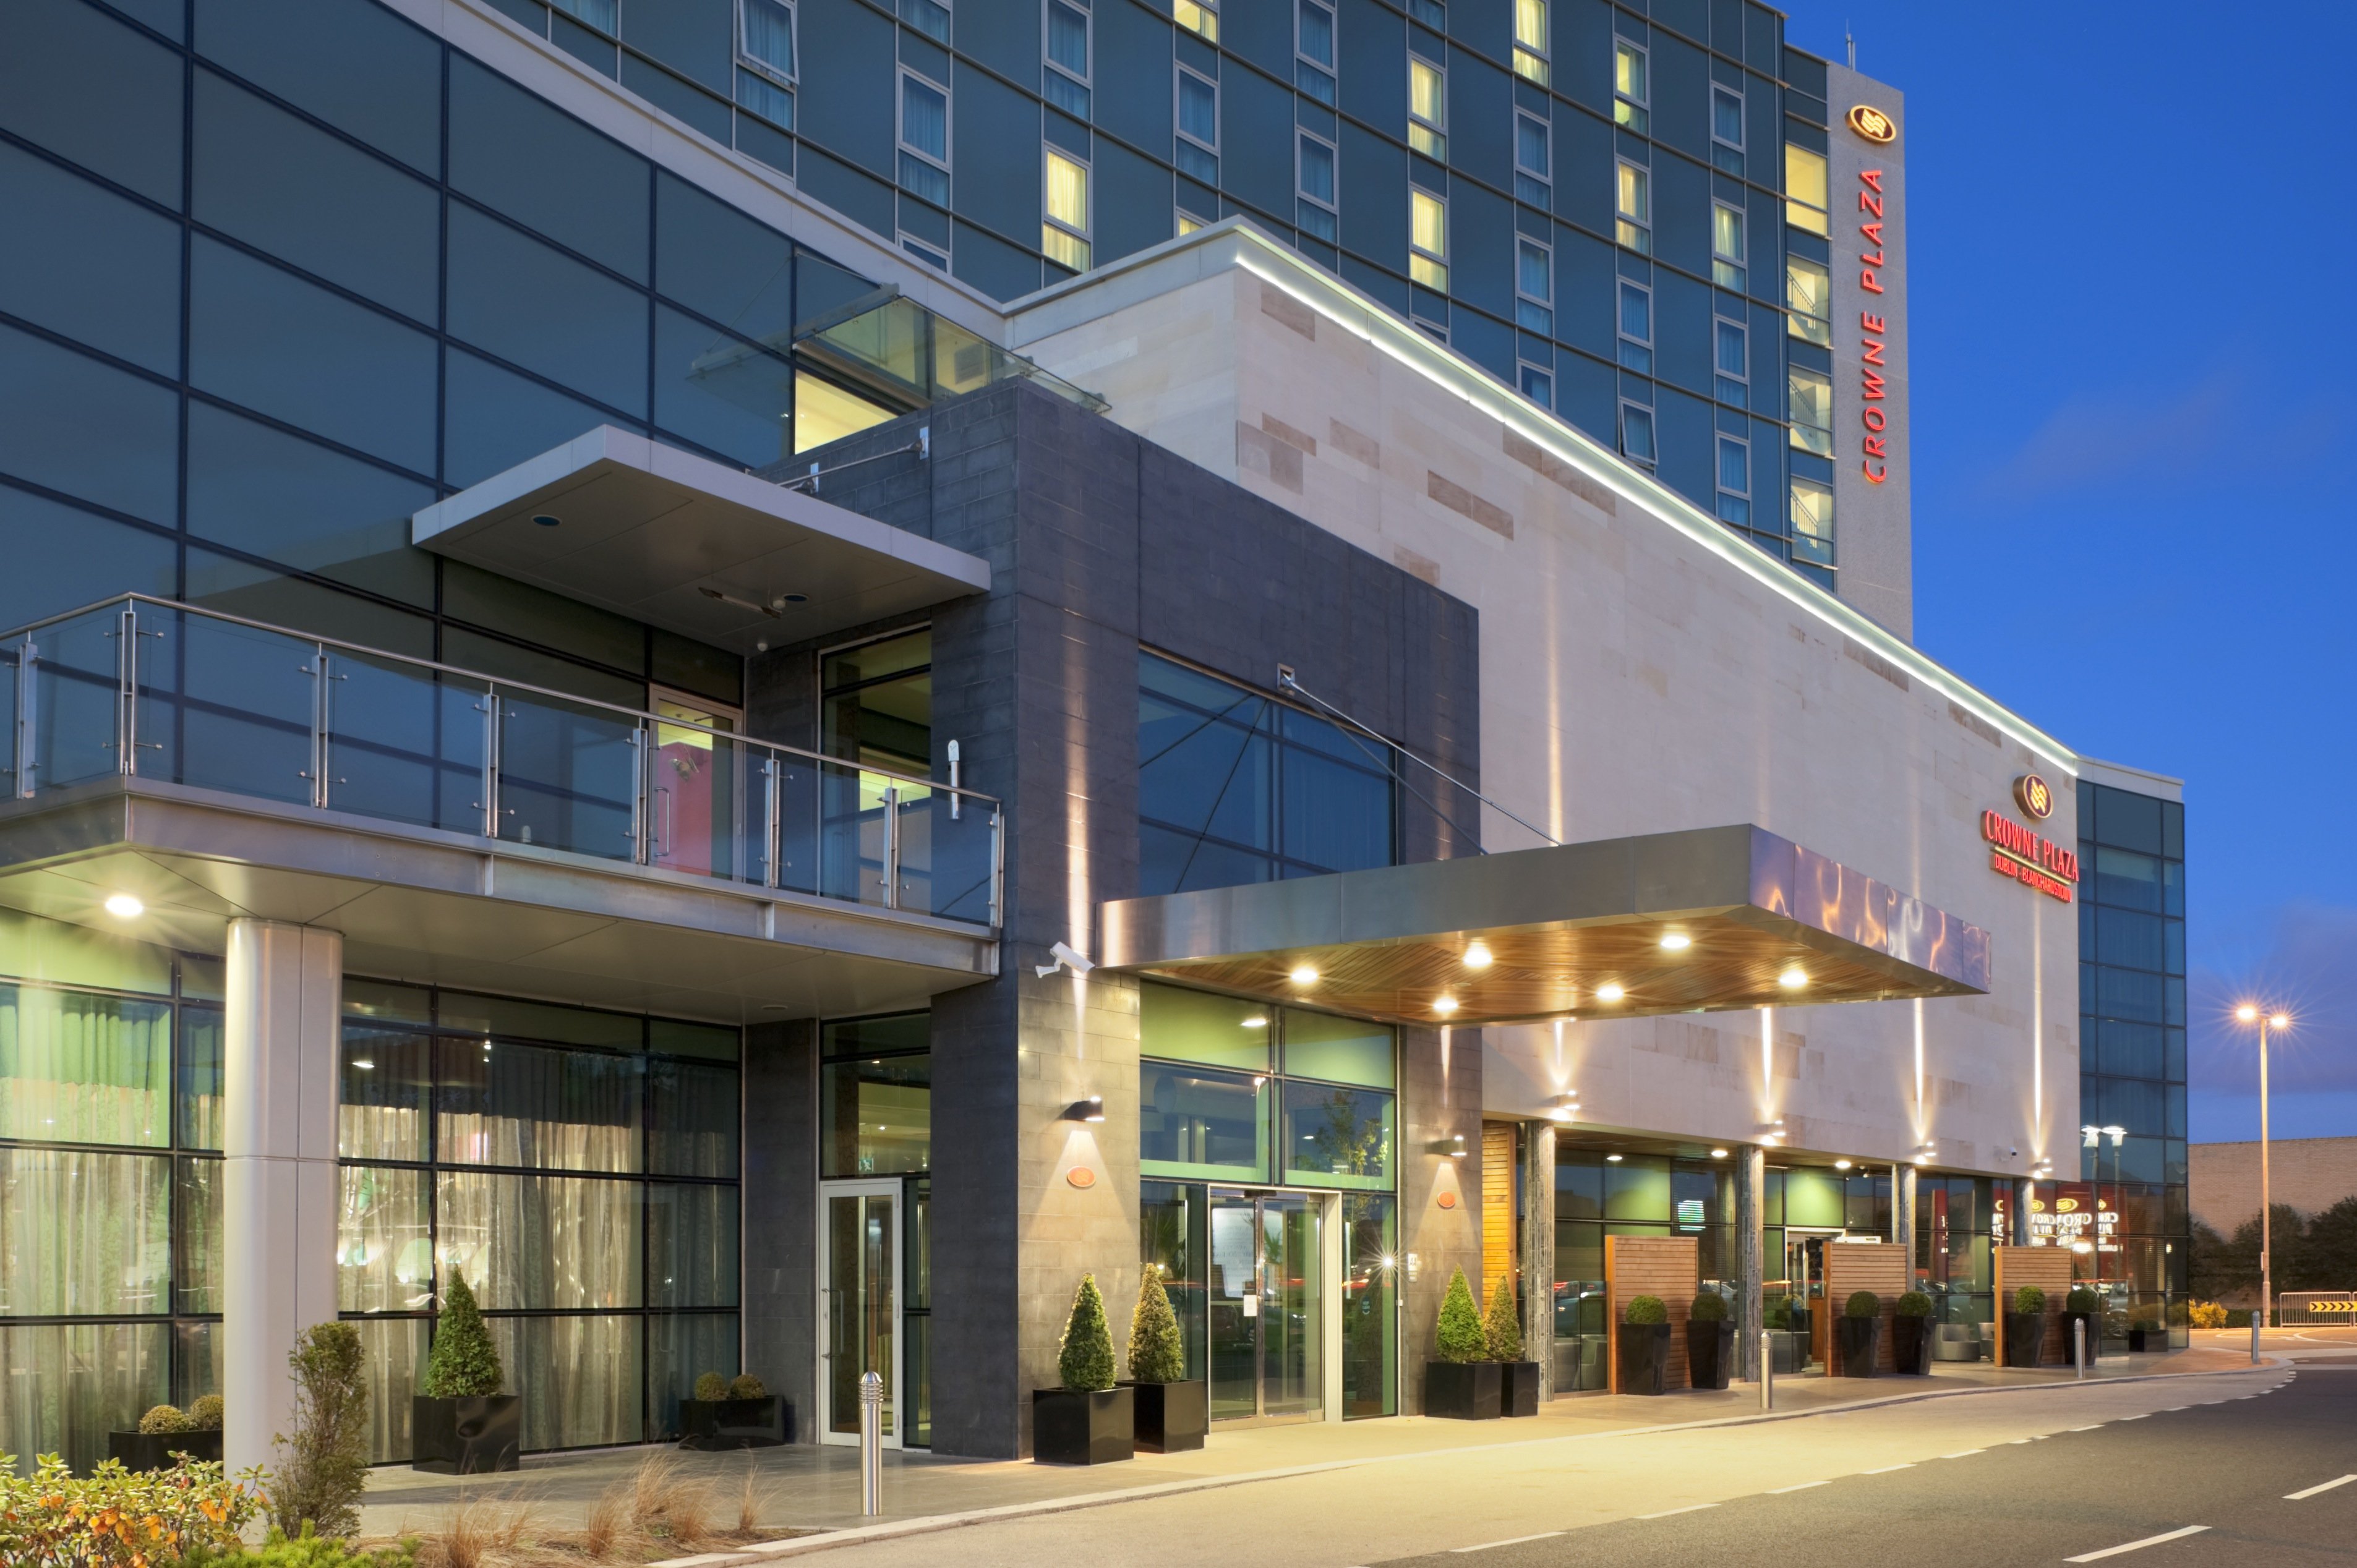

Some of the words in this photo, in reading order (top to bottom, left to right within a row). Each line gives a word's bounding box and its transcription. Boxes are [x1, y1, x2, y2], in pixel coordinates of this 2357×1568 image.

[1860, 169, 1884, 294] PLAZA
[1862, 311, 1886, 484] CROWNE
[1985, 809, 2038, 862] CROWNE
[2043, 838, 2079, 882] PLAZA
[1995, 853, 2017, 877] DUBLIN
